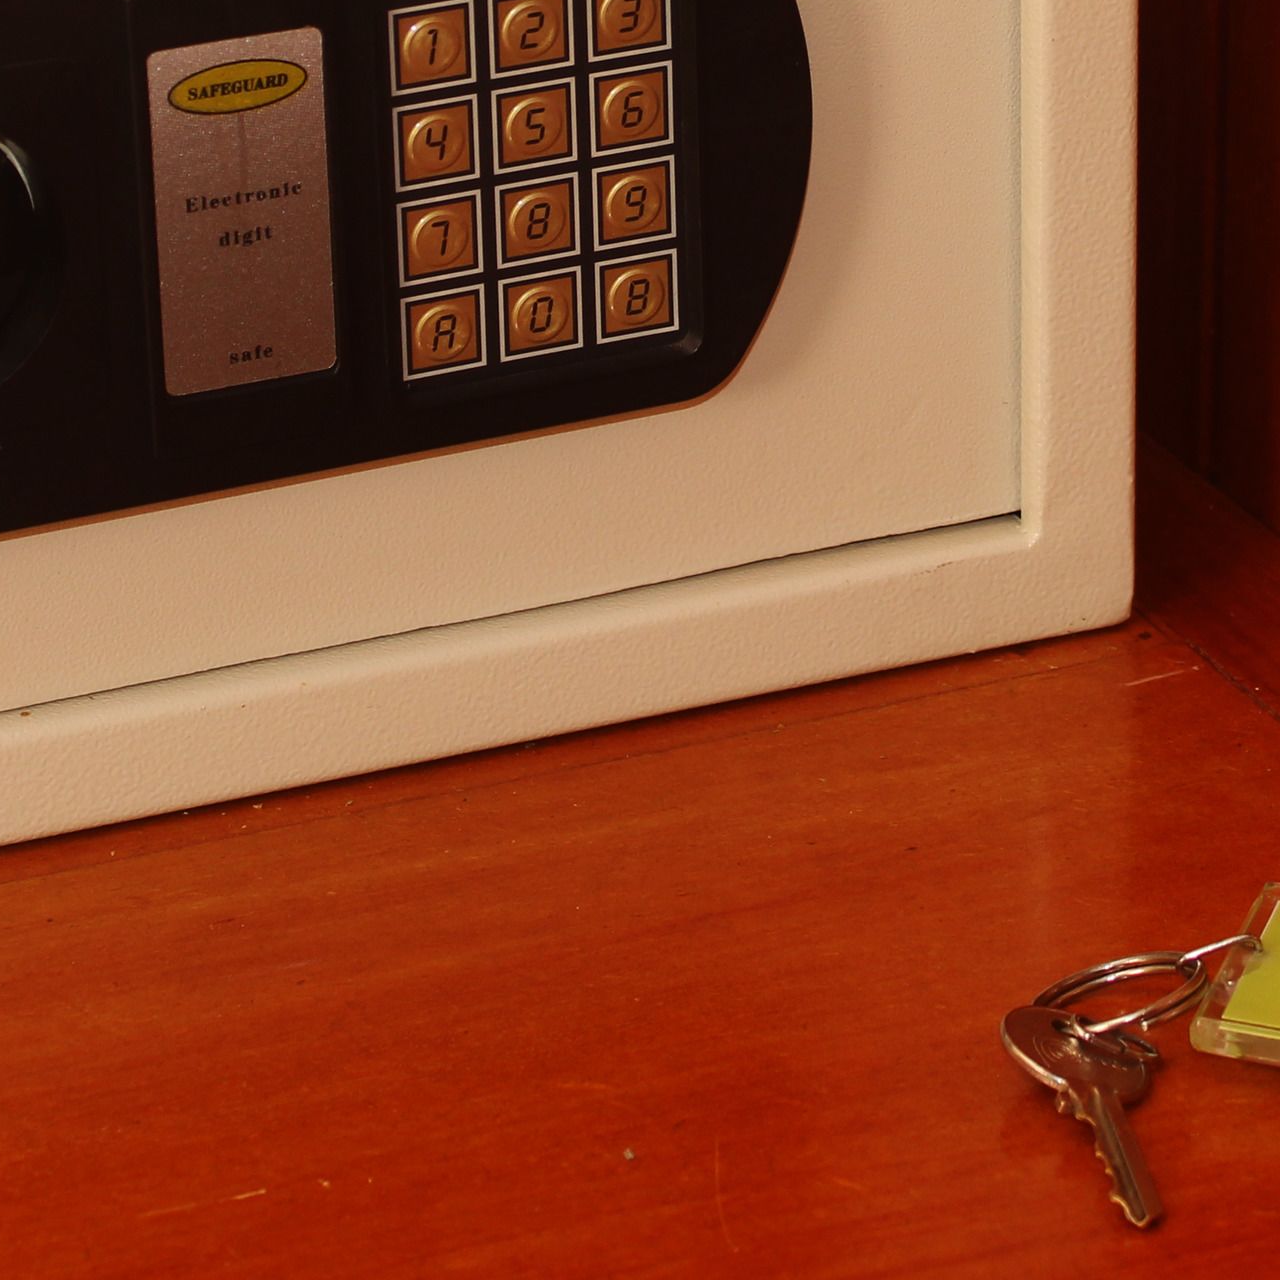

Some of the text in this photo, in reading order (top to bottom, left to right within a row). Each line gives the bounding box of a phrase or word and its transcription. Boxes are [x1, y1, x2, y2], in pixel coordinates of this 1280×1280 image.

[427, 29, 438, 65] 1
[520, 11, 545, 50] 2
[187, 72, 289, 102] SAFEGUARD
[525, 107, 545, 145] 5
[621, 91, 644, 128] 6
[425, 124, 448, 161] 4
[185, 181, 303, 214] Electronic
[624, 185, 647, 222] 9
[218, 225, 274, 249] digit
[431, 220, 450, 256] 7
[526, 202, 551, 240] 8
[529, 295, 554, 333] 0
[431, 313, 457, 353] A
[228, 344, 274, 365] safe
